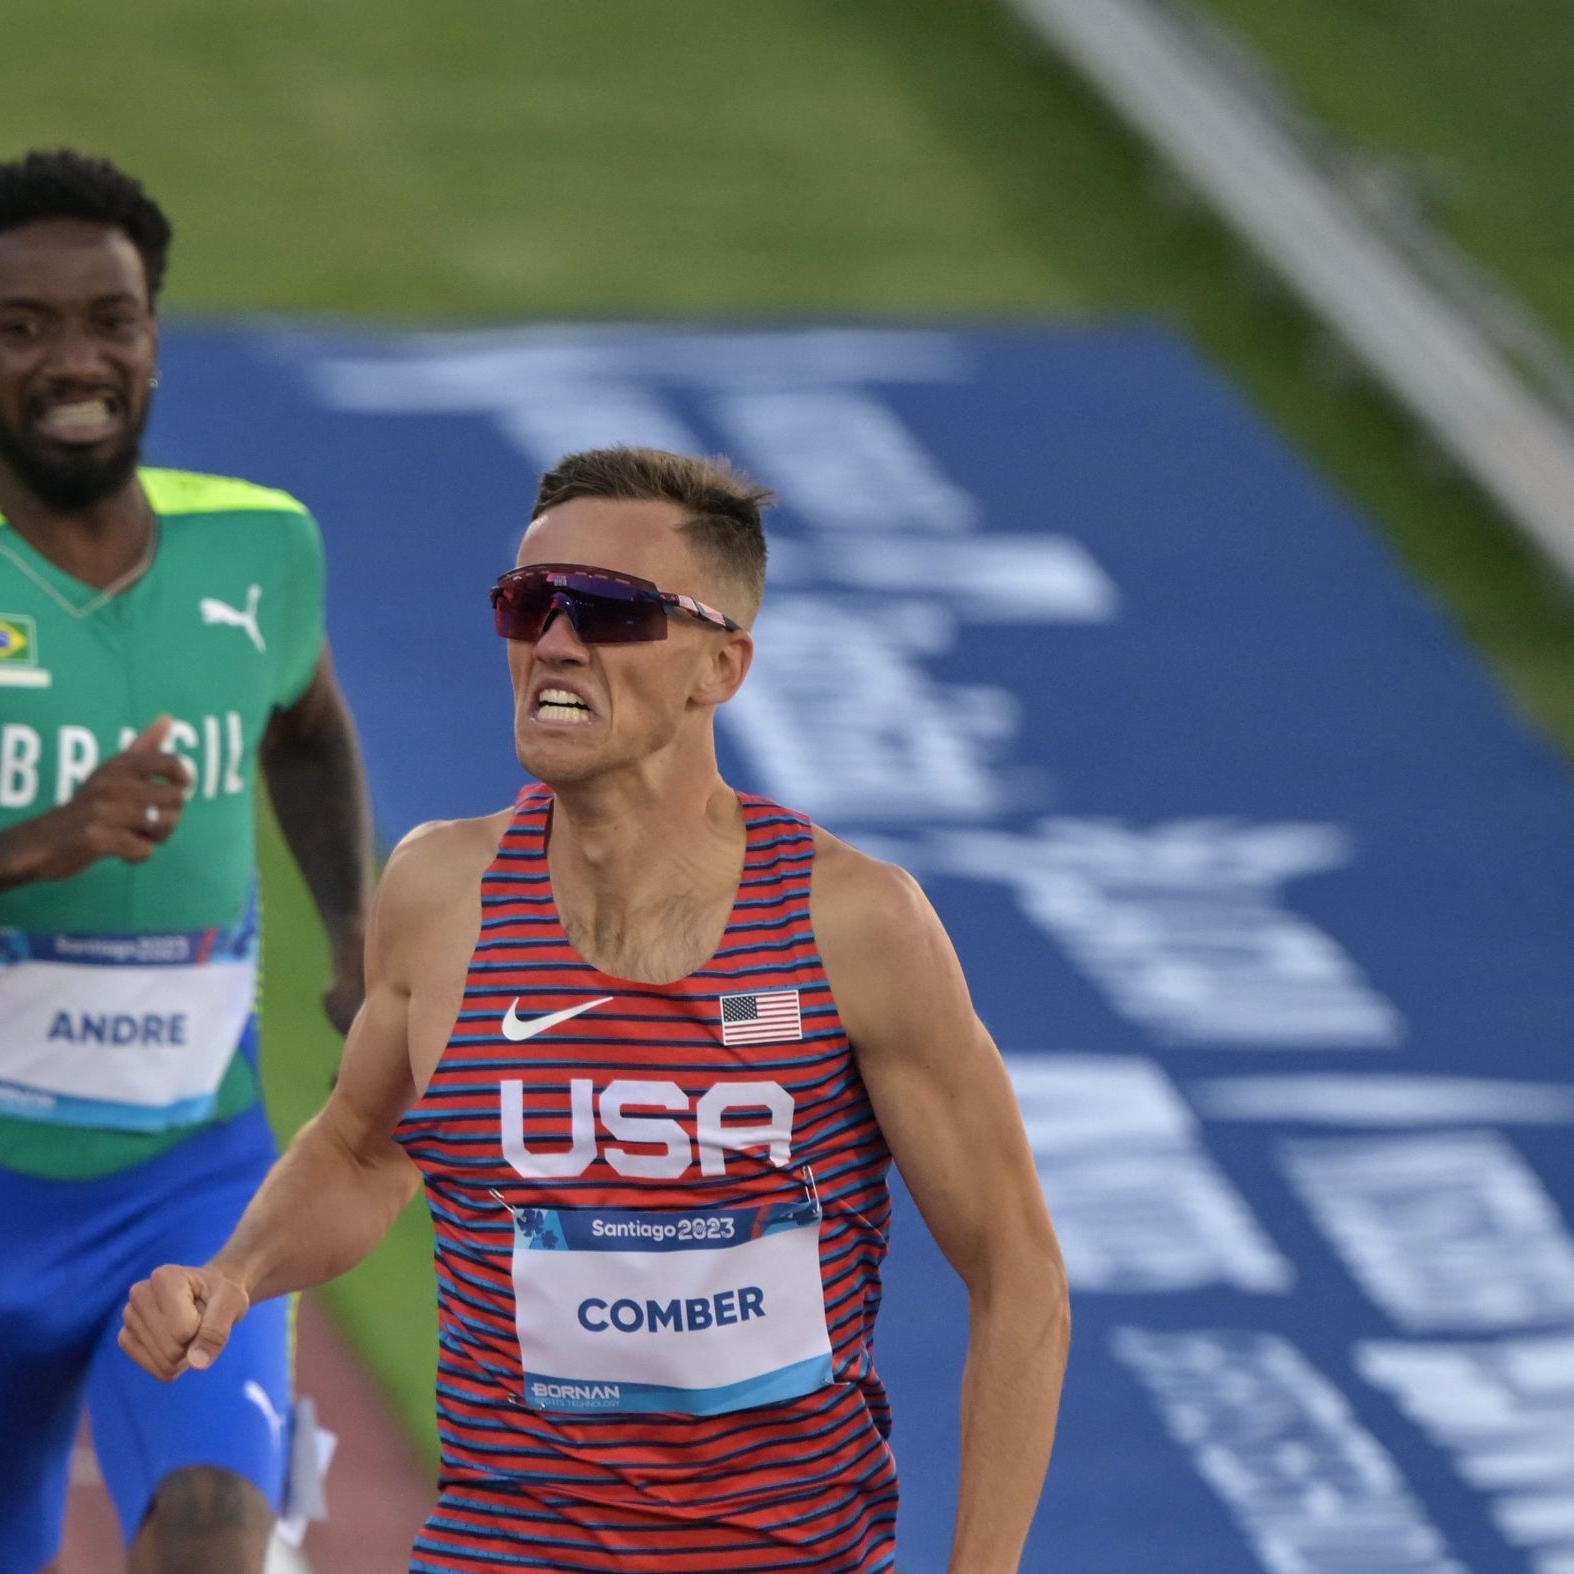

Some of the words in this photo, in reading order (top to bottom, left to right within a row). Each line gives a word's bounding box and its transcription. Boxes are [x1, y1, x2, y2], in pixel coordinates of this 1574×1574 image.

[48, 1007, 188, 1047] ANDRE
[500, 1079, 795, 1179] USA
[577, 1286, 766, 1333] COMBER
[531, 1382, 620, 1399] BORNAN
